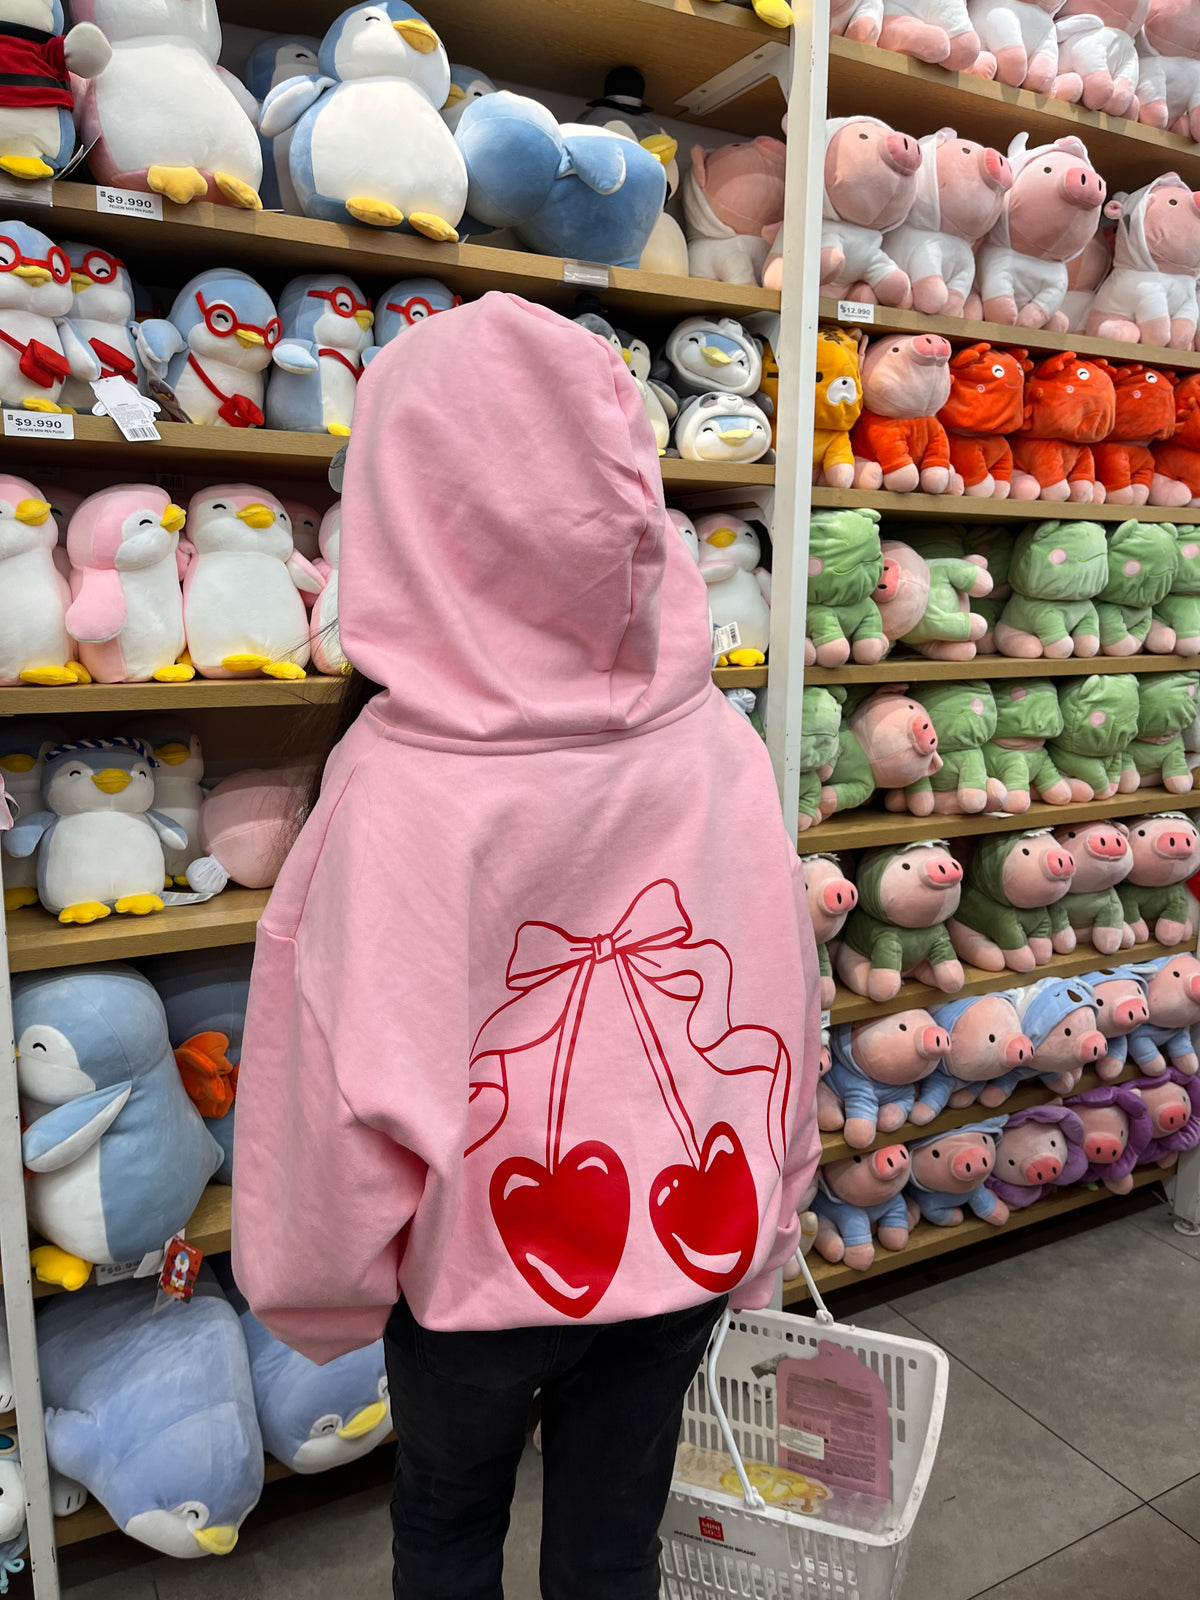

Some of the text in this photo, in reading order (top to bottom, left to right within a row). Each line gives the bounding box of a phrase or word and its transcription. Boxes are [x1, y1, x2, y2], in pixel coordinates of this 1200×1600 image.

[107, 194, 152, 209] $9.990
[15, 418, 62, 429] $9.990
[701, 1521, 721, 1531] MINI
[703, 1538, 734, 1551] DESIGNER
[734, 1546, 757, 1557] BRAND
